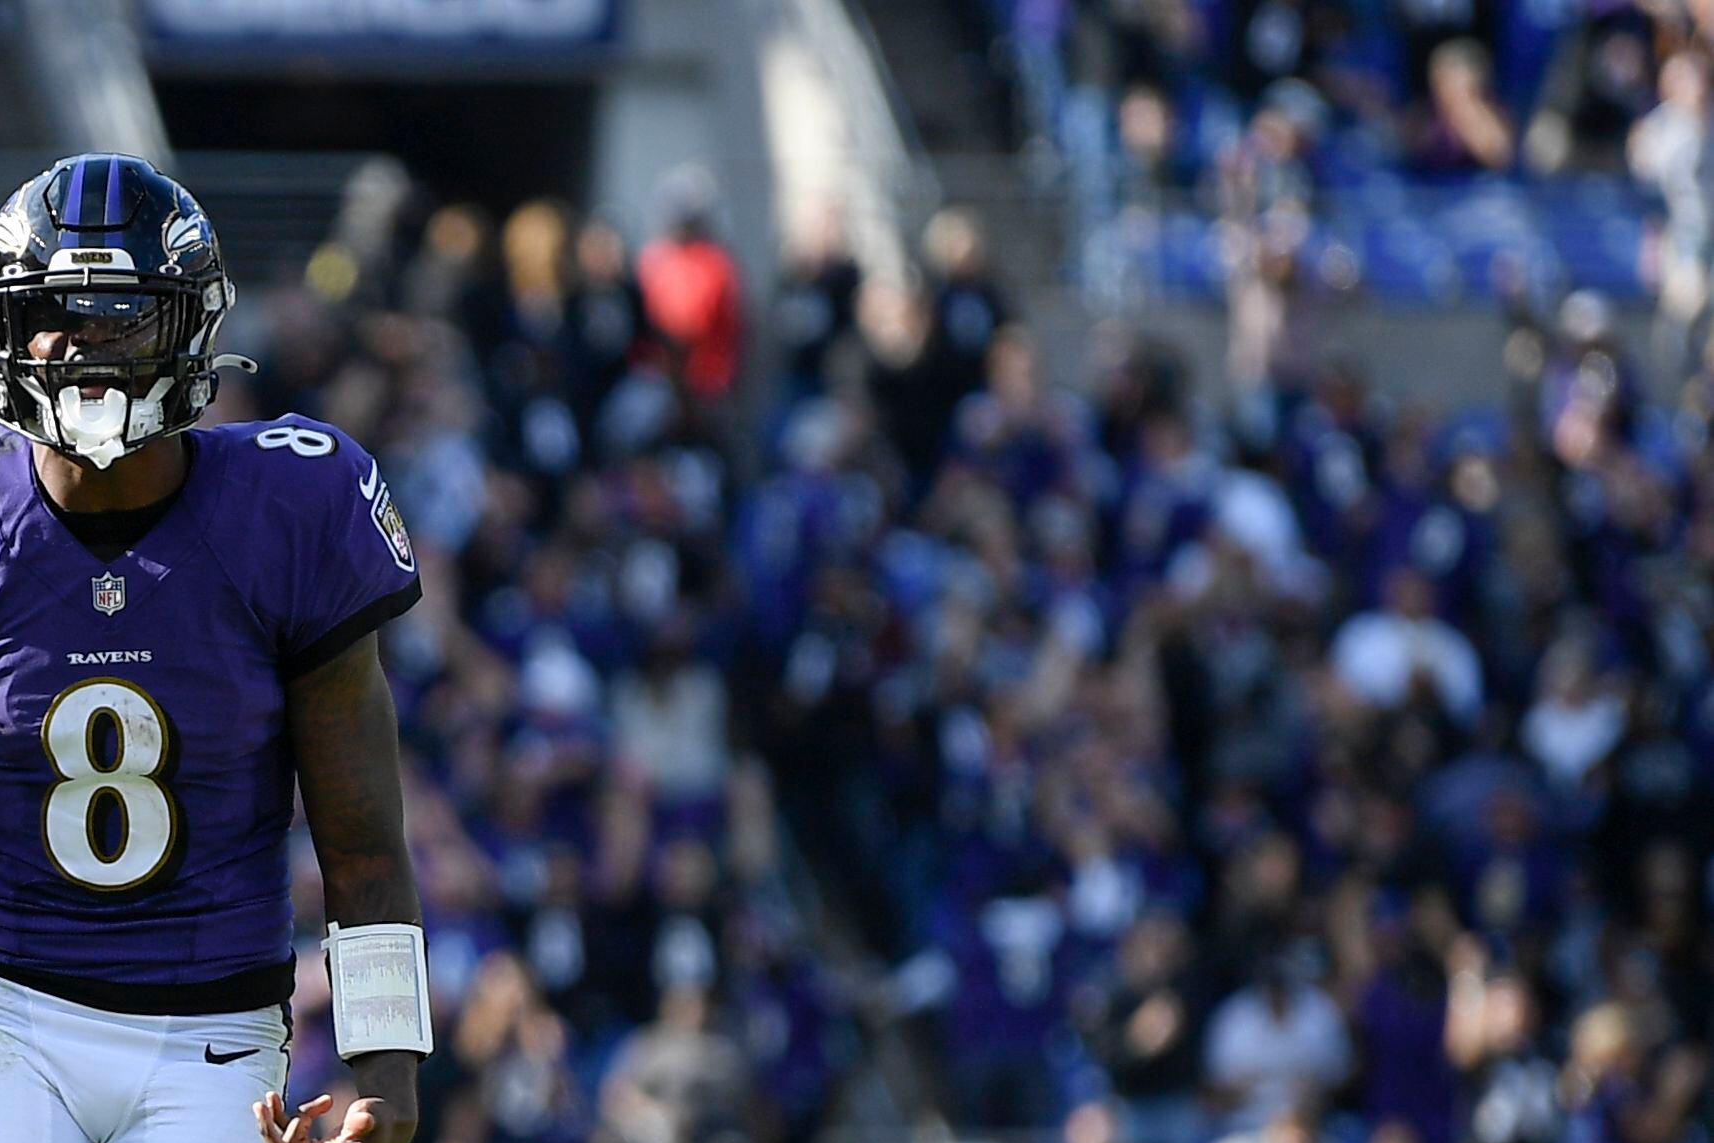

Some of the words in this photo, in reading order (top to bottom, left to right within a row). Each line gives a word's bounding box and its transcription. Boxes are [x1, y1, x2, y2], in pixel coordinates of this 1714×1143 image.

[255, 426, 336, 456] 8
[98, 591, 120, 606] NFL
[66, 650, 153, 665] RAVENS
[41, 677, 177, 892] 8
